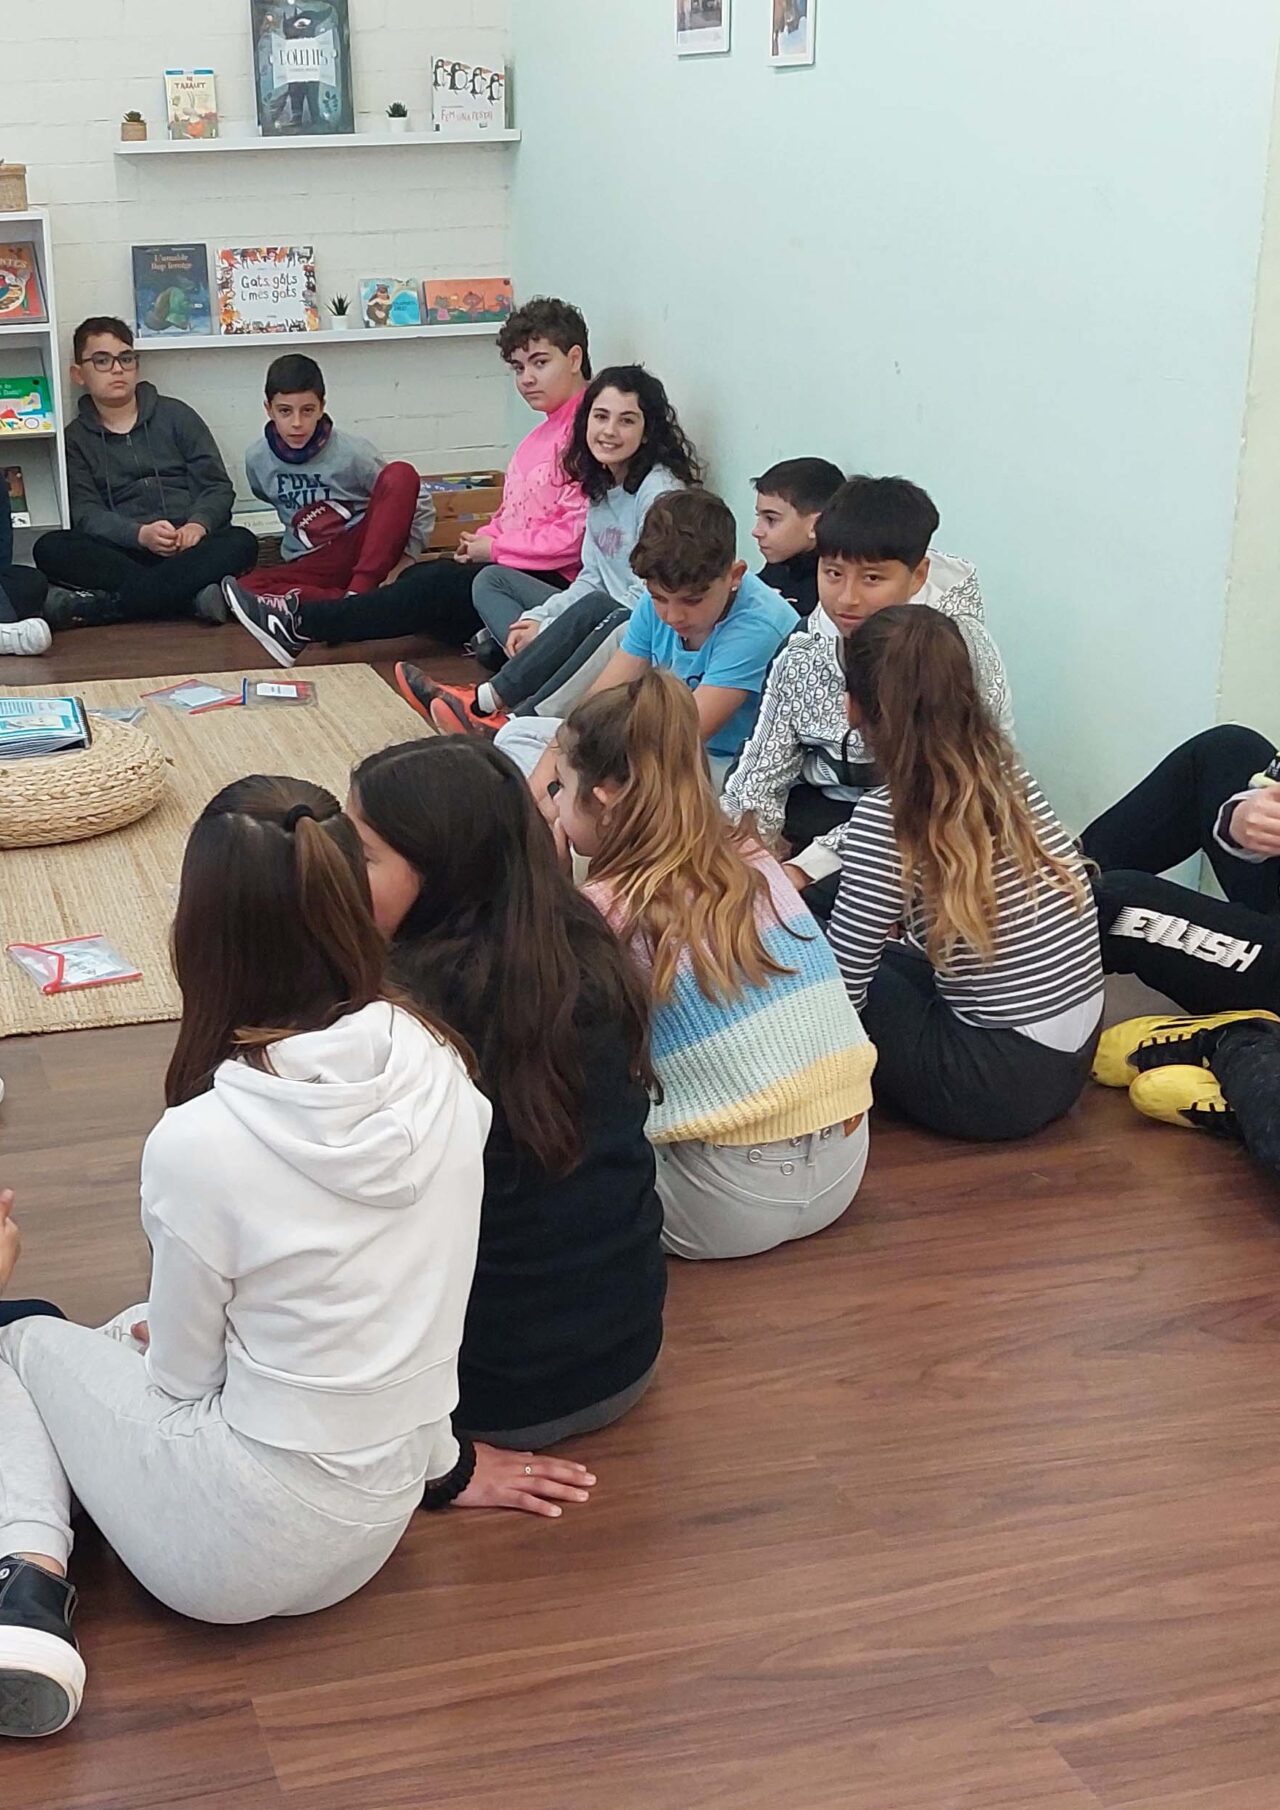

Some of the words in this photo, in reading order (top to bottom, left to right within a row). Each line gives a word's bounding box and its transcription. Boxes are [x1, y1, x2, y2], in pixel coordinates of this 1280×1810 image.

[276, 473, 331, 494] FULL
[277, 487, 332, 510] SKILL
[1107, 905, 1263, 973] EILISH
